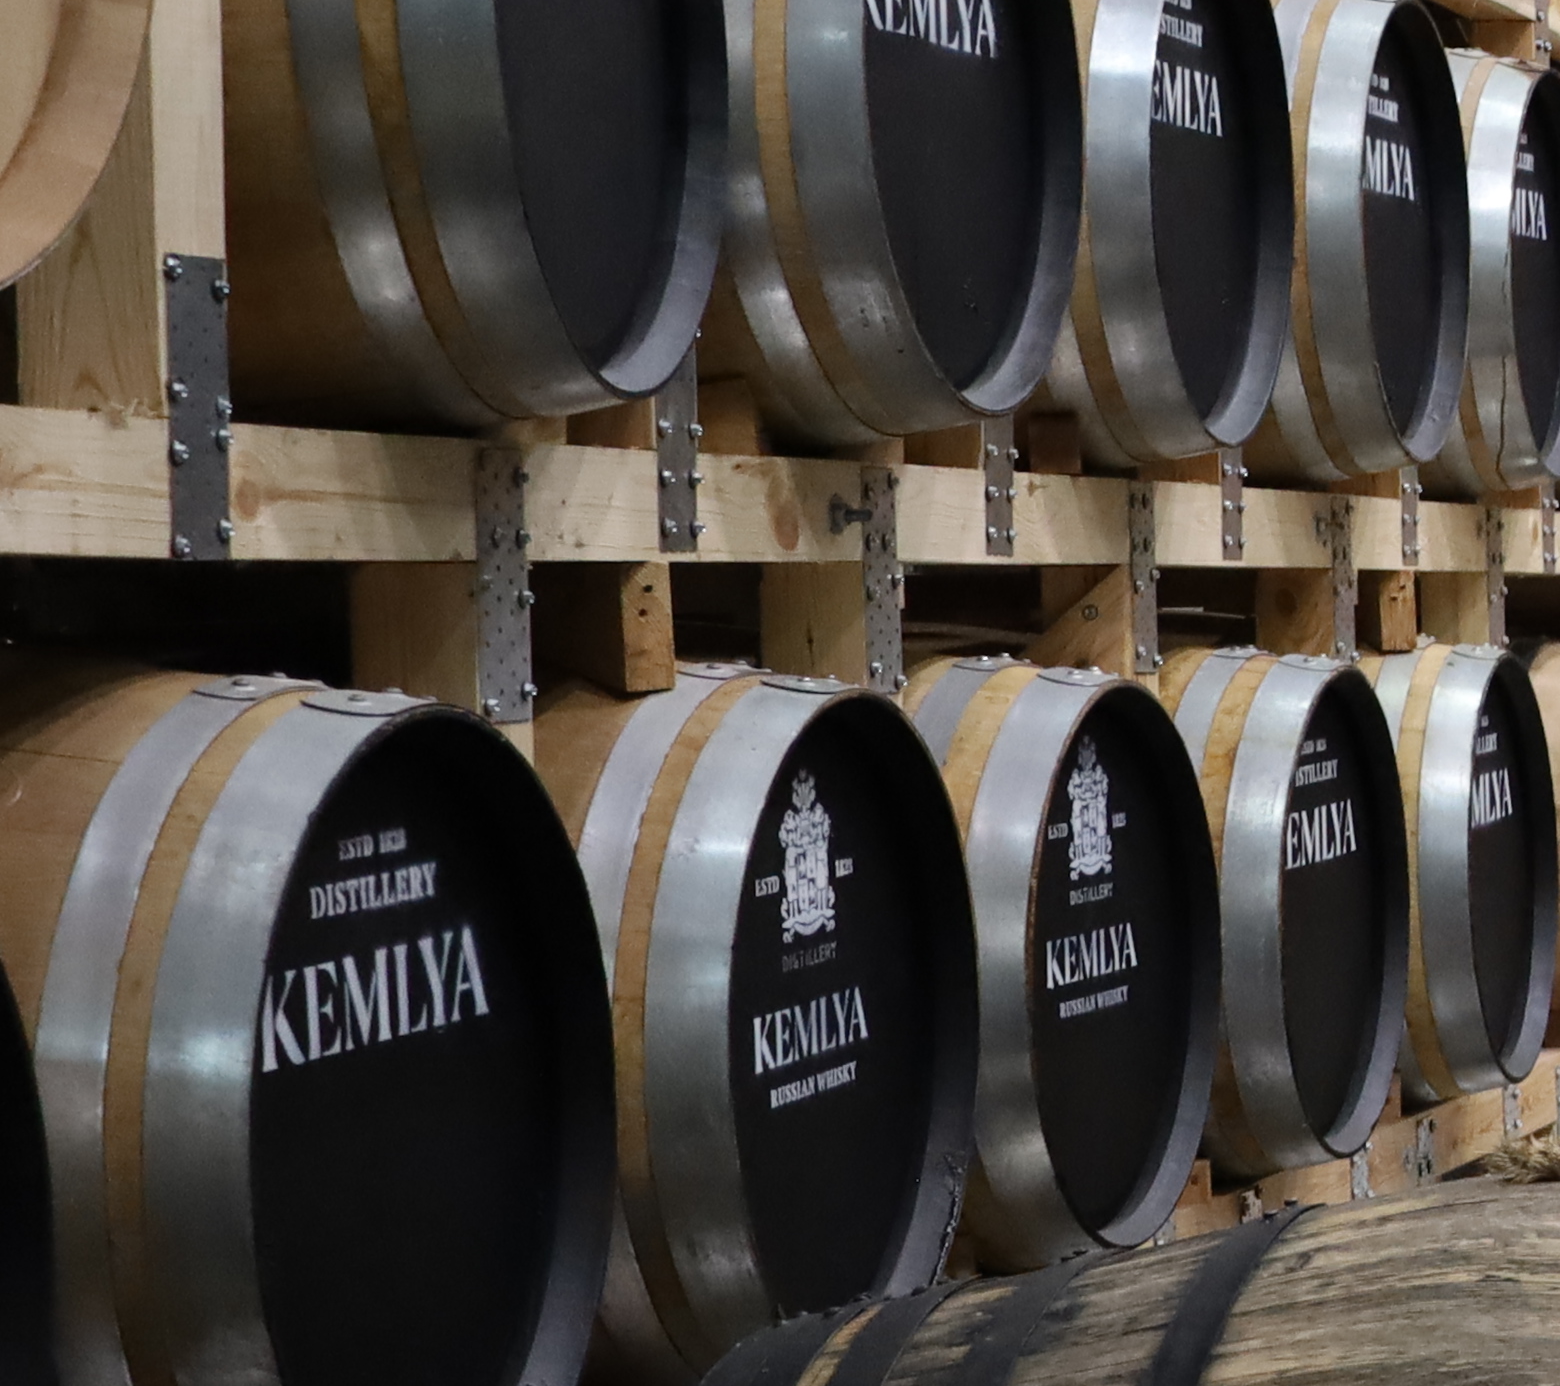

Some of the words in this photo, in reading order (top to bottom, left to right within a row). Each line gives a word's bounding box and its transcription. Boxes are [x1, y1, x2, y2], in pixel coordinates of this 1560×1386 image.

[1161, 13, 1203, 48] STILLERY
[1362, 135, 1415, 201] MLYA
[1471, 767, 1513, 829] MLYA
[1285, 798, 1357, 870] EMLYA
[310, 862, 436, 920] DISTILLERY
[755, 875, 780, 897] ESTD
[1046, 922, 1138, 989] KEMLYA
[262, 924, 490, 1073] KEMLYA
[753, 986, 869, 1075] KEMLYA
[770, 1073, 815, 1109] RUSSIAN
[816, 1060, 858, 1093] WHISKY
